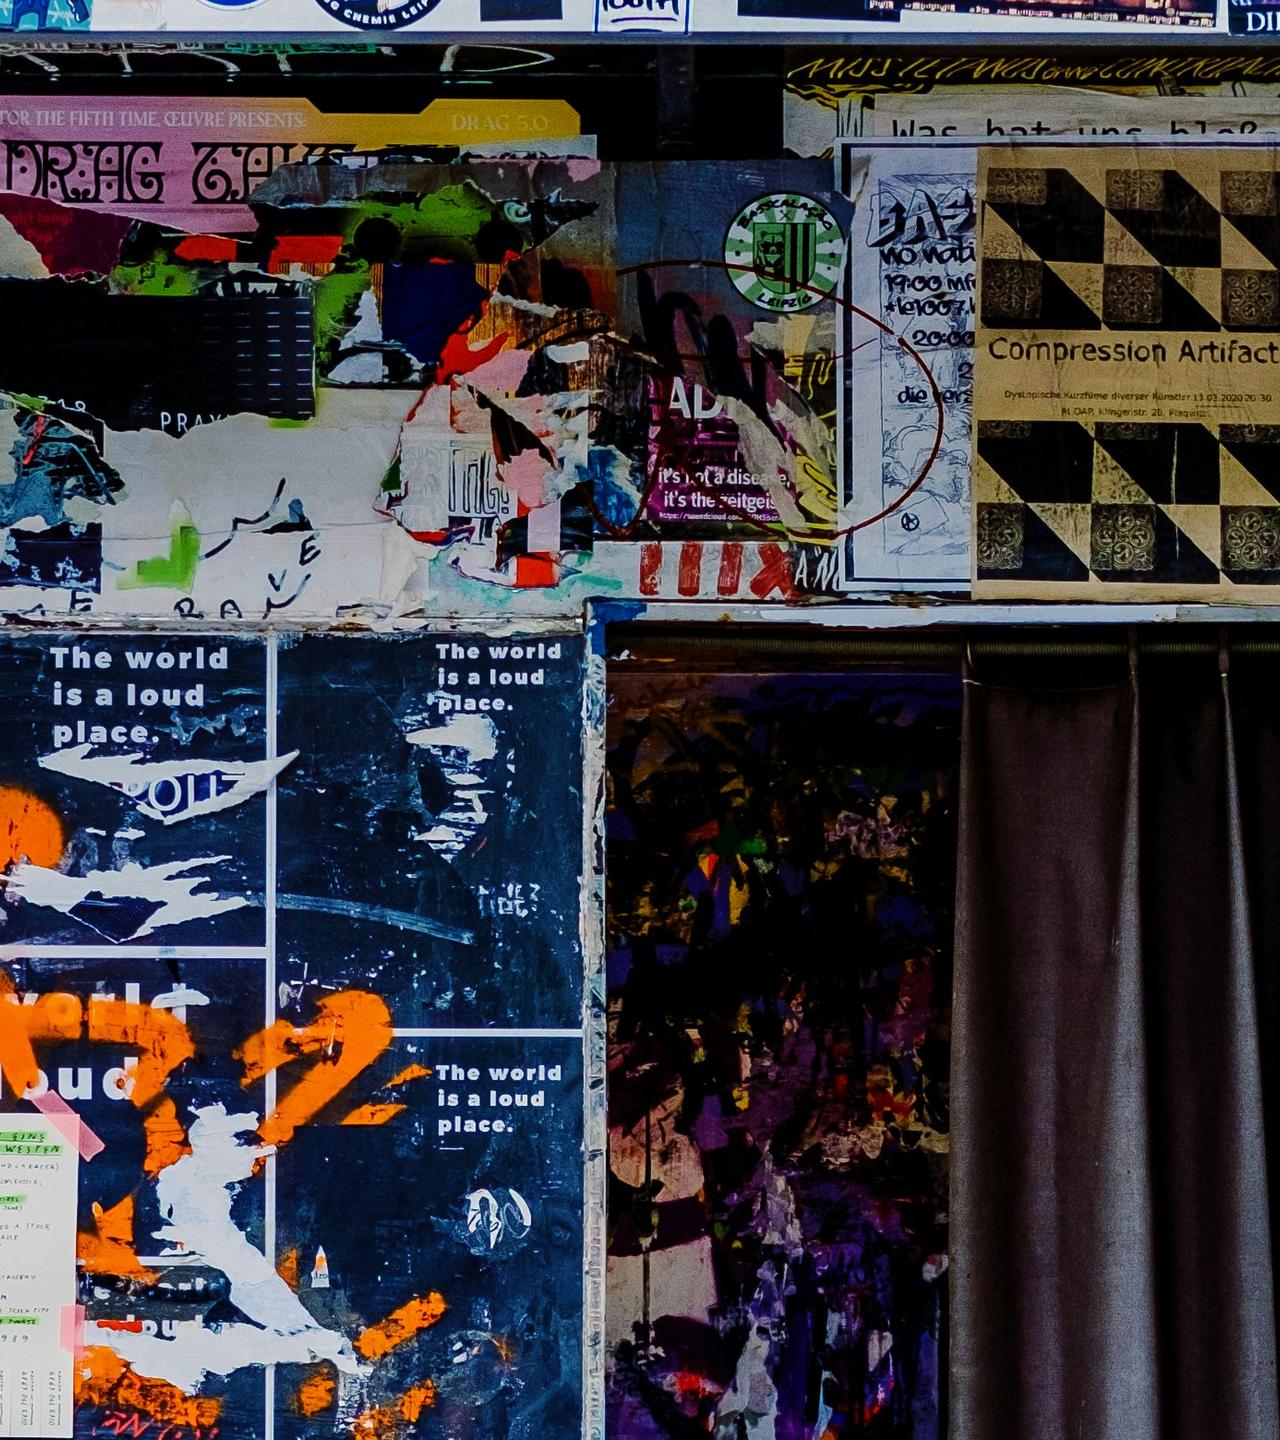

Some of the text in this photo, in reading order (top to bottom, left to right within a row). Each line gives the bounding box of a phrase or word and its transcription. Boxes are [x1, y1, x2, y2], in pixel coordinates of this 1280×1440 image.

[0, 109, 306, 129] FOR THE FIFTH PRESENTS:
[451, 115, 549, 132] DRAG 5.0
[1, 139, 165, 205] DRAG
[885, 275, 942, 293] 19:00
[757, 293, 813, 308] LEIPZIG
[988, 337, 1166, 371] Compression
[664, 492, 688, 508] it's
[50, 647, 230, 670] The world
[436, 643, 562, 661] The world
[438, 668, 545, 686] is loud
[54, 682, 206, 707] is a loud
[438, 694, 514, 714] place.
[53, 720, 160, 747] place.
[436, 1064, 562, 1082] The world
[438, 1090, 545, 1107] is loud
[438, 1116, 514, 1136] place.
[5, 1145, 61, 1154] WESTEN
